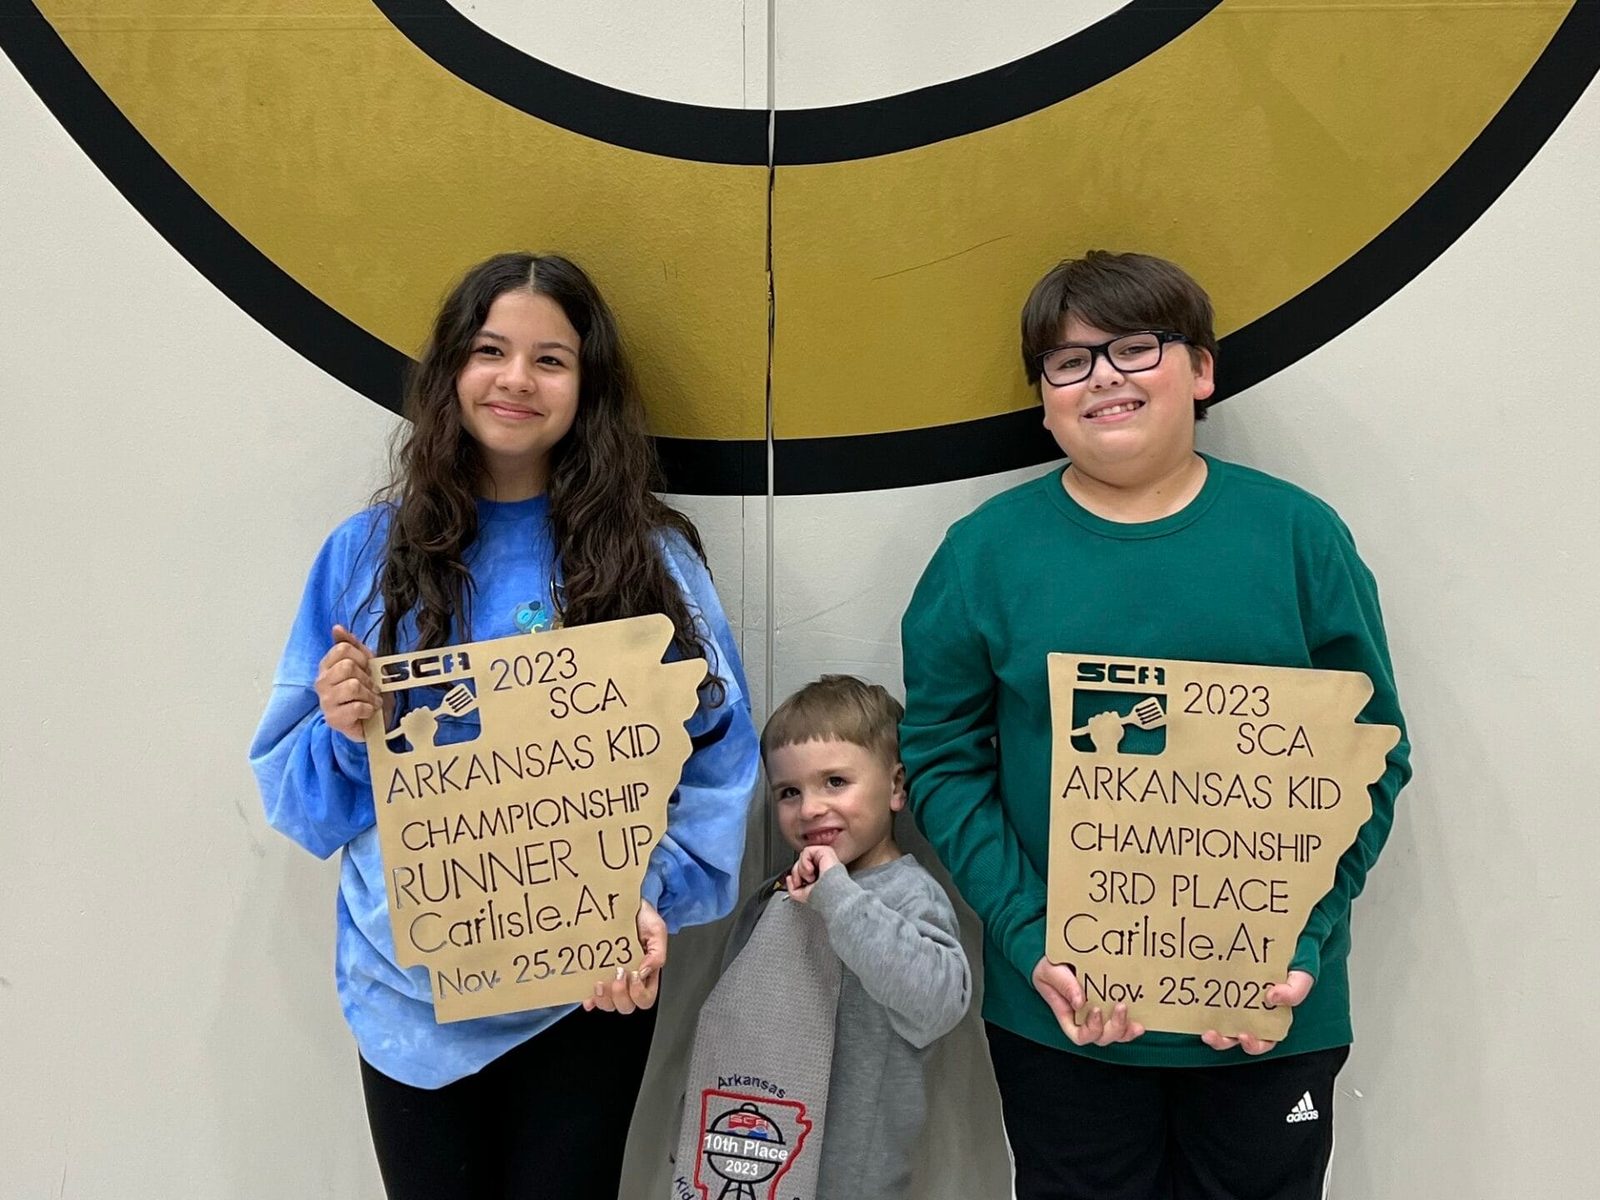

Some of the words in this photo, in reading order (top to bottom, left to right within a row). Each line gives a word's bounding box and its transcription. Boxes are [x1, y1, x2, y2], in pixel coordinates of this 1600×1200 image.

[381, 652, 471, 685] SCA
[490, 647, 578, 692] 2023
[1077, 661, 1166, 686] SCA
[550, 678, 628, 719] SCA
[1184, 682, 1270, 717] 2023
[1237, 722, 1314, 757] SCA
[386, 734, 594, 804] ARKANSAS
[606, 723, 660, 763] KID
[1062, 765, 1272, 809] ARKANSAS
[1288, 775, 1341, 810] KID
[401, 782, 649, 851] CHAMPIONSHIP
[1070, 821, 1322, 863] CHAMPIONSHIP
[392, 838, 579, 909] RUNNER
[598, 824, 653, 871] UP
[1088, 870, 1156, 905] 3RD
[1172, 874, 1289, 914] PLACE
[438, 967, 501, 1000] Nov.
[513, 936, 633, 984] 25.2023
[1084, 973, 1144, 1002] Nov.
[718, 1074, 786, 1099] Arkansas
[1286, 1110, 1319, 1123] adidas
[704, 1134, 738, 1153] 10th
[744, 1140, 788, 1160] Place
[725, 1160, 758, 1176] 2023
